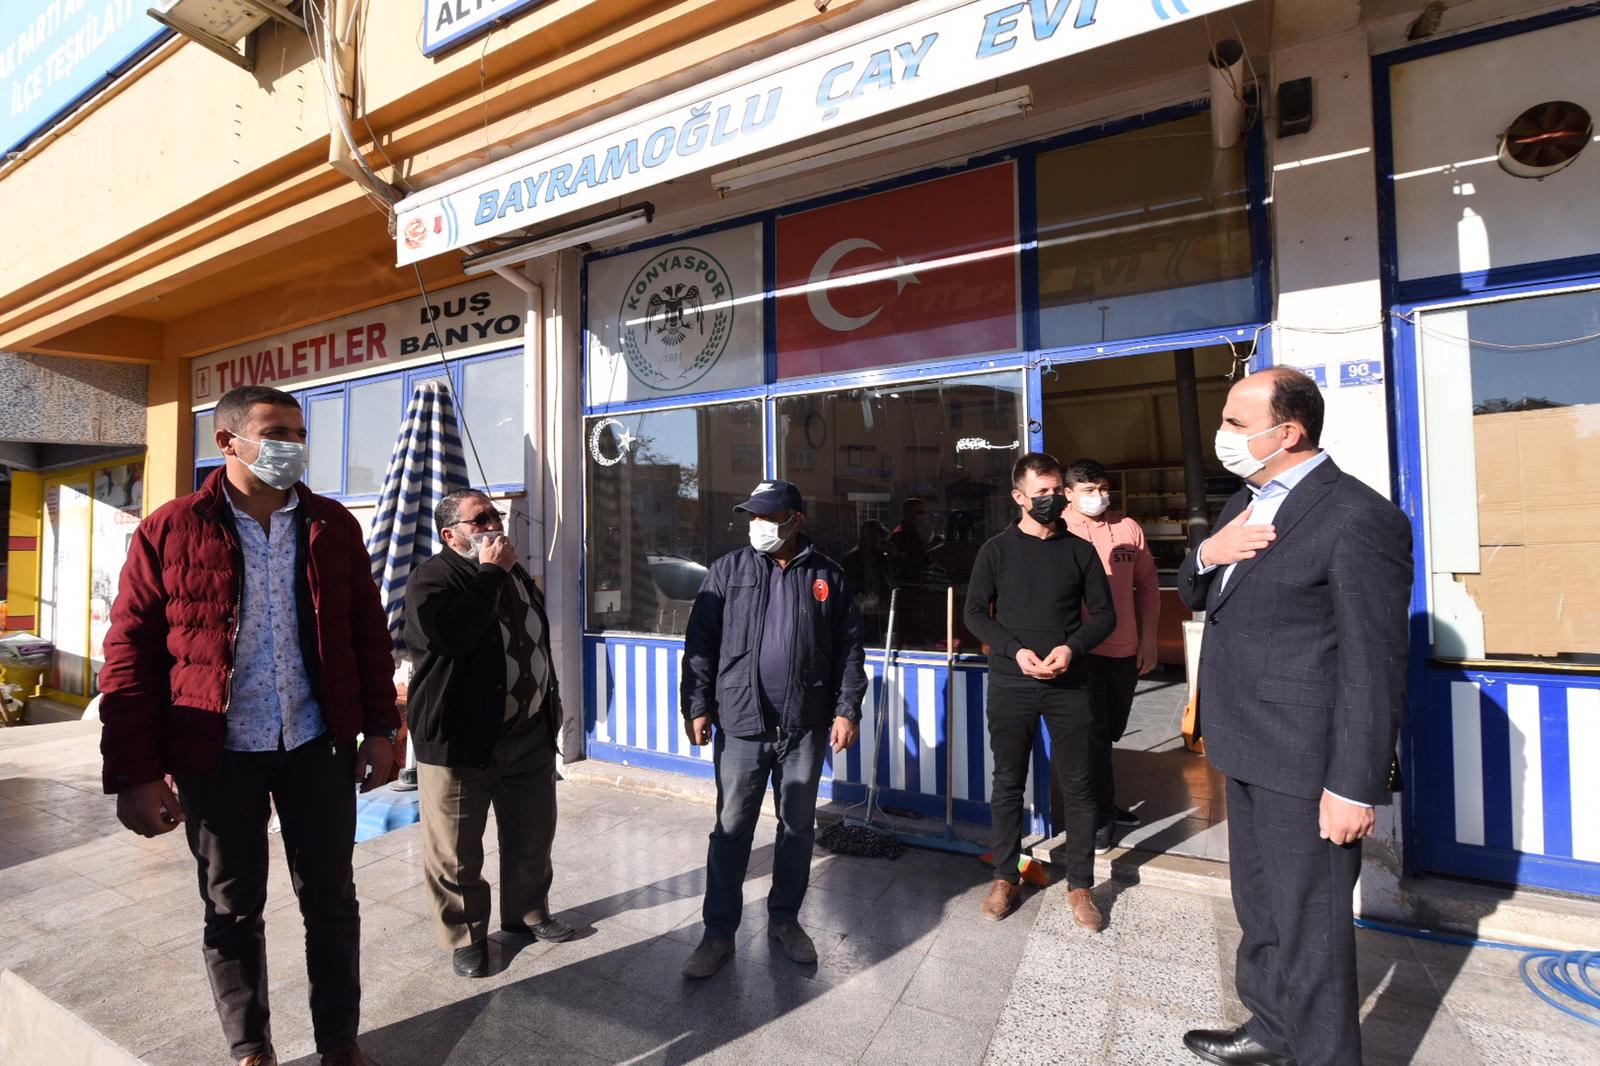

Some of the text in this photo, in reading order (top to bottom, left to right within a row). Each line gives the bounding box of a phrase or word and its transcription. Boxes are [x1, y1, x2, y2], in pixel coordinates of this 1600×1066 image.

[474, 87, 783, 226] BAYRAMOĞLU
[816, 33, 939, 121] ÇAY
[420, 292, 491, 325] DUŞ
[628, 255, 725, 311] KONYASPOR
[216, 314, 521, 393] TUVALETLER BANYO
